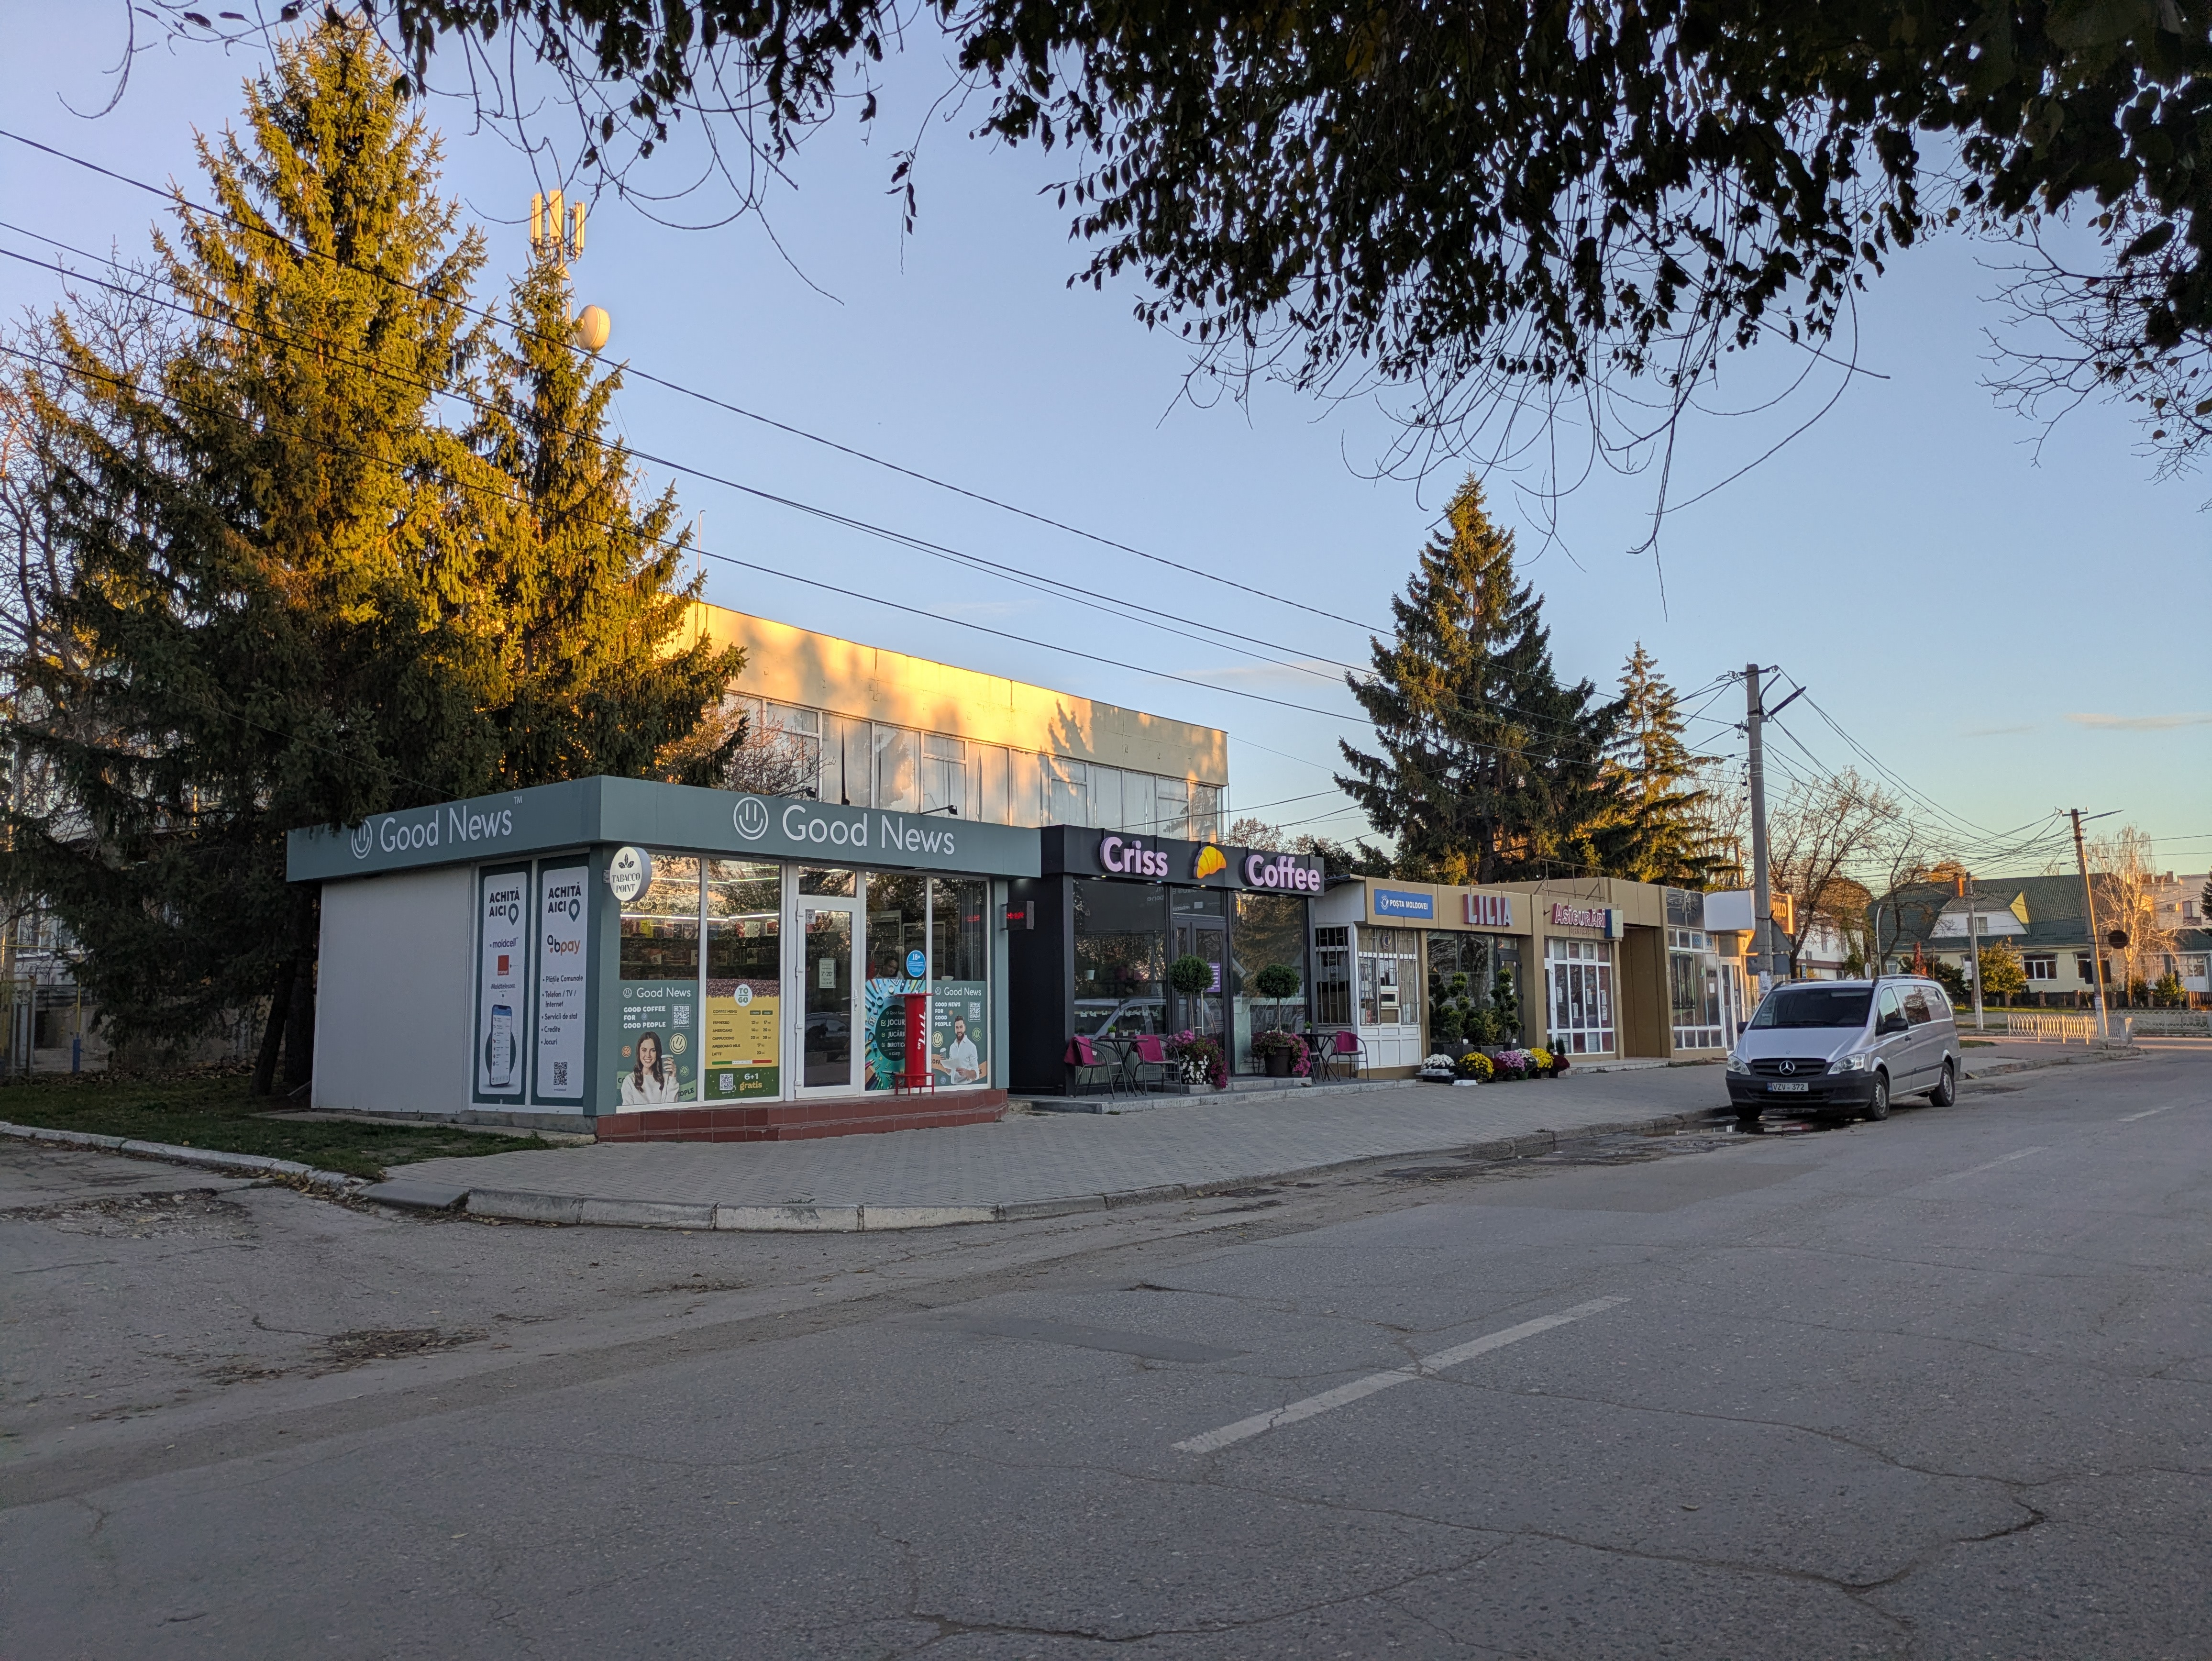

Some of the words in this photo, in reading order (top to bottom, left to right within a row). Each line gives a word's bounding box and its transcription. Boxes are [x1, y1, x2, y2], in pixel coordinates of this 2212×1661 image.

[380, 810, 439, 853] Good
[449, 806, 512, 843] News
[783, 805, 867, 847] Good
[881, 815, 954, 855] News
[1100, 836, 1168, 876] Criss
[1245, 854, 1320, 891] Coffee
[612, 873, 641, 883] TABACCO
[489, 886, 520, 903] ACHITĂ
[548, 881, 581, 899] ACHITĂ
[616, 884, 635, 893] POINT
[548, 901, 566, 913] AICI
[1405, 900, 1428, 909] MOLDOVEI
[1463, 894, 1514, 927] LILIA
[489, 905, 506, 917] AICI
[492, 938, 516, 948] moldcell
[637, 987, 663, 998] Good
[666, 987, 691, 997] News
[944, 987, 962, 996] Good
[964, 987, 981, 996] News
[740, 1081, 762, 1091] gratis
